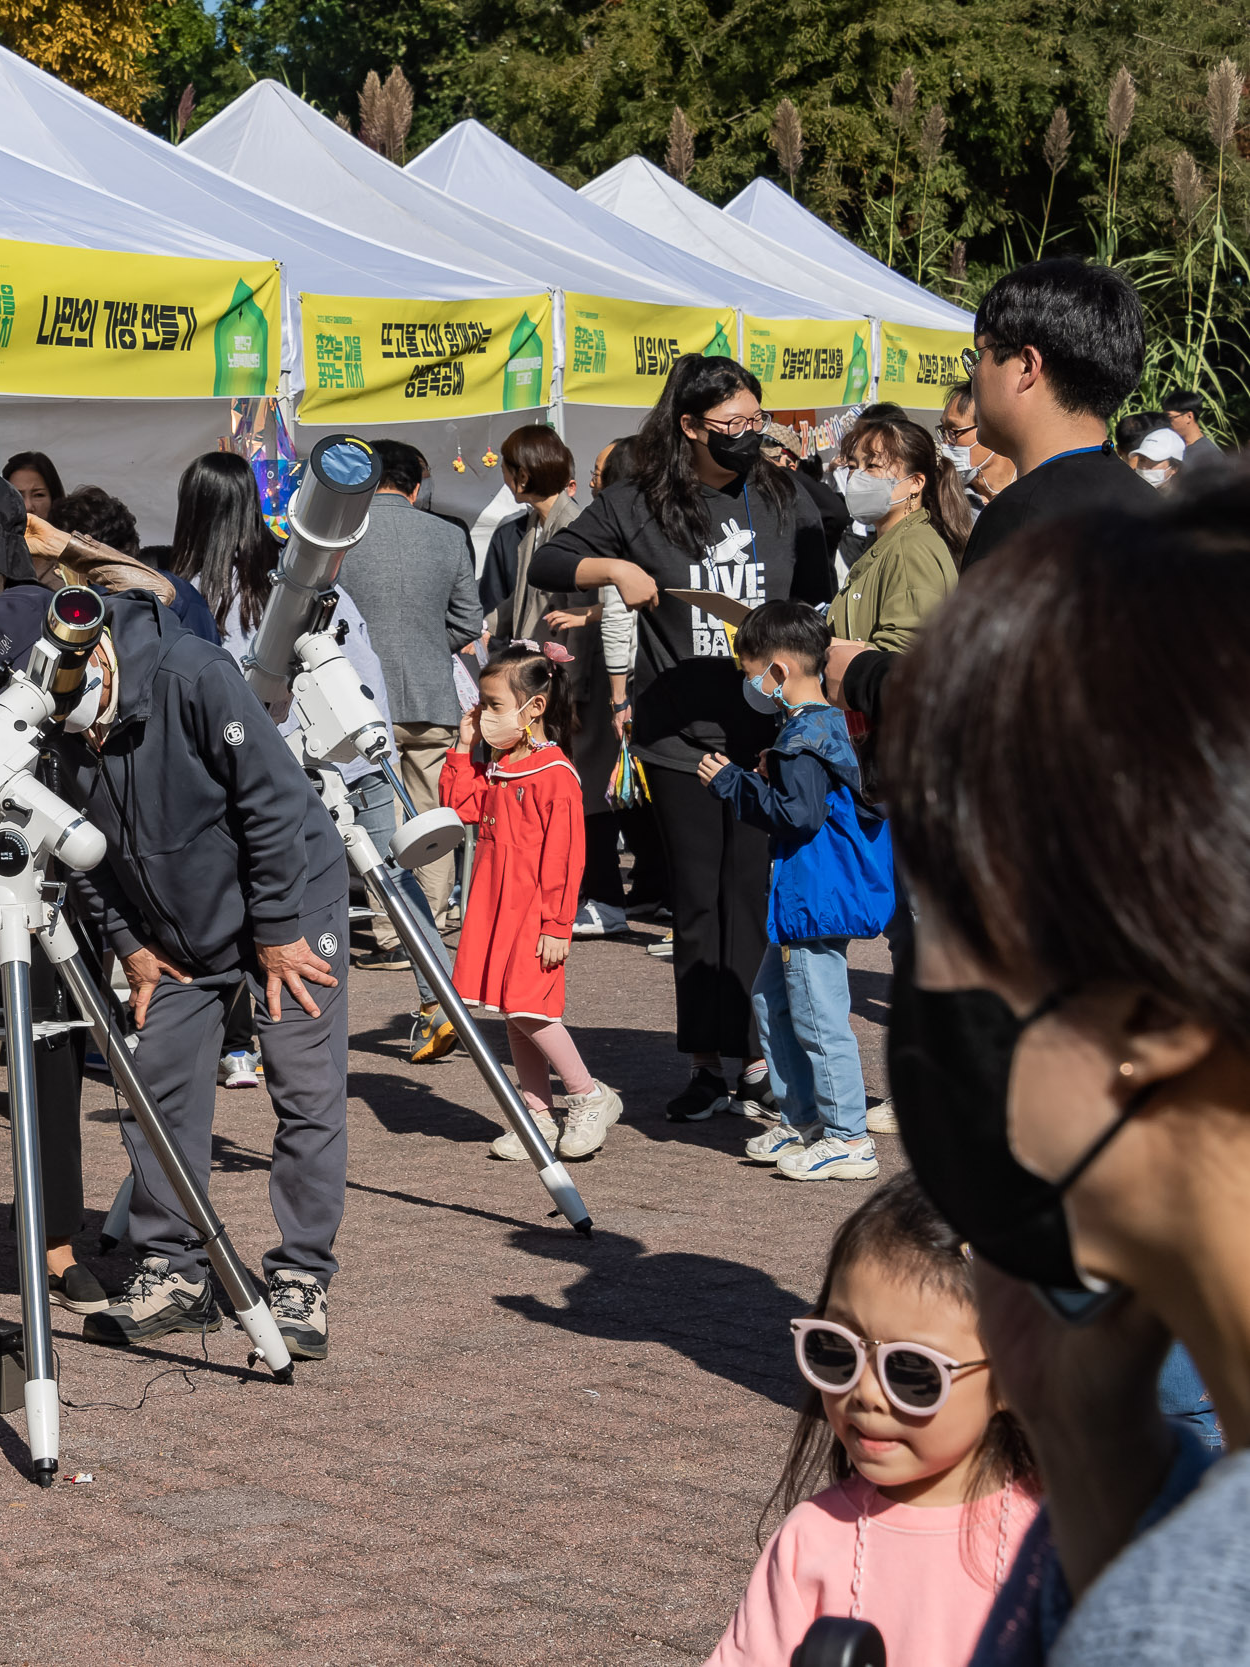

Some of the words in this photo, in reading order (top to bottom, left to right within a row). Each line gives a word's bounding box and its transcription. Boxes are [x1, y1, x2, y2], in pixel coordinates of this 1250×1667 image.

[36, 295, 99, 348] 나만의
[103, 300, 138, 350] 가방
[141, 303, 198, 351] 만들기
[443, 321, 492, 356] 함께하는
[575, 325, 594, 350] 춤추는
[593, 329, 606, 351] 마을
[316, 333, 343, 361] 춤추는
[344, 336, 362, 362] 마을
[573, 350, 592, 373] 꿈꾸는
[317, 362, 344, 389] 꿈꾸는
[344, 362, 365, 389] 자치
[780, 348, 813, 380] 오늘부터
[813, 348, 843, 380] 에코생활
[916, 352, 938, 384] 친절한
[689, 563, 766, 599] LIVE
